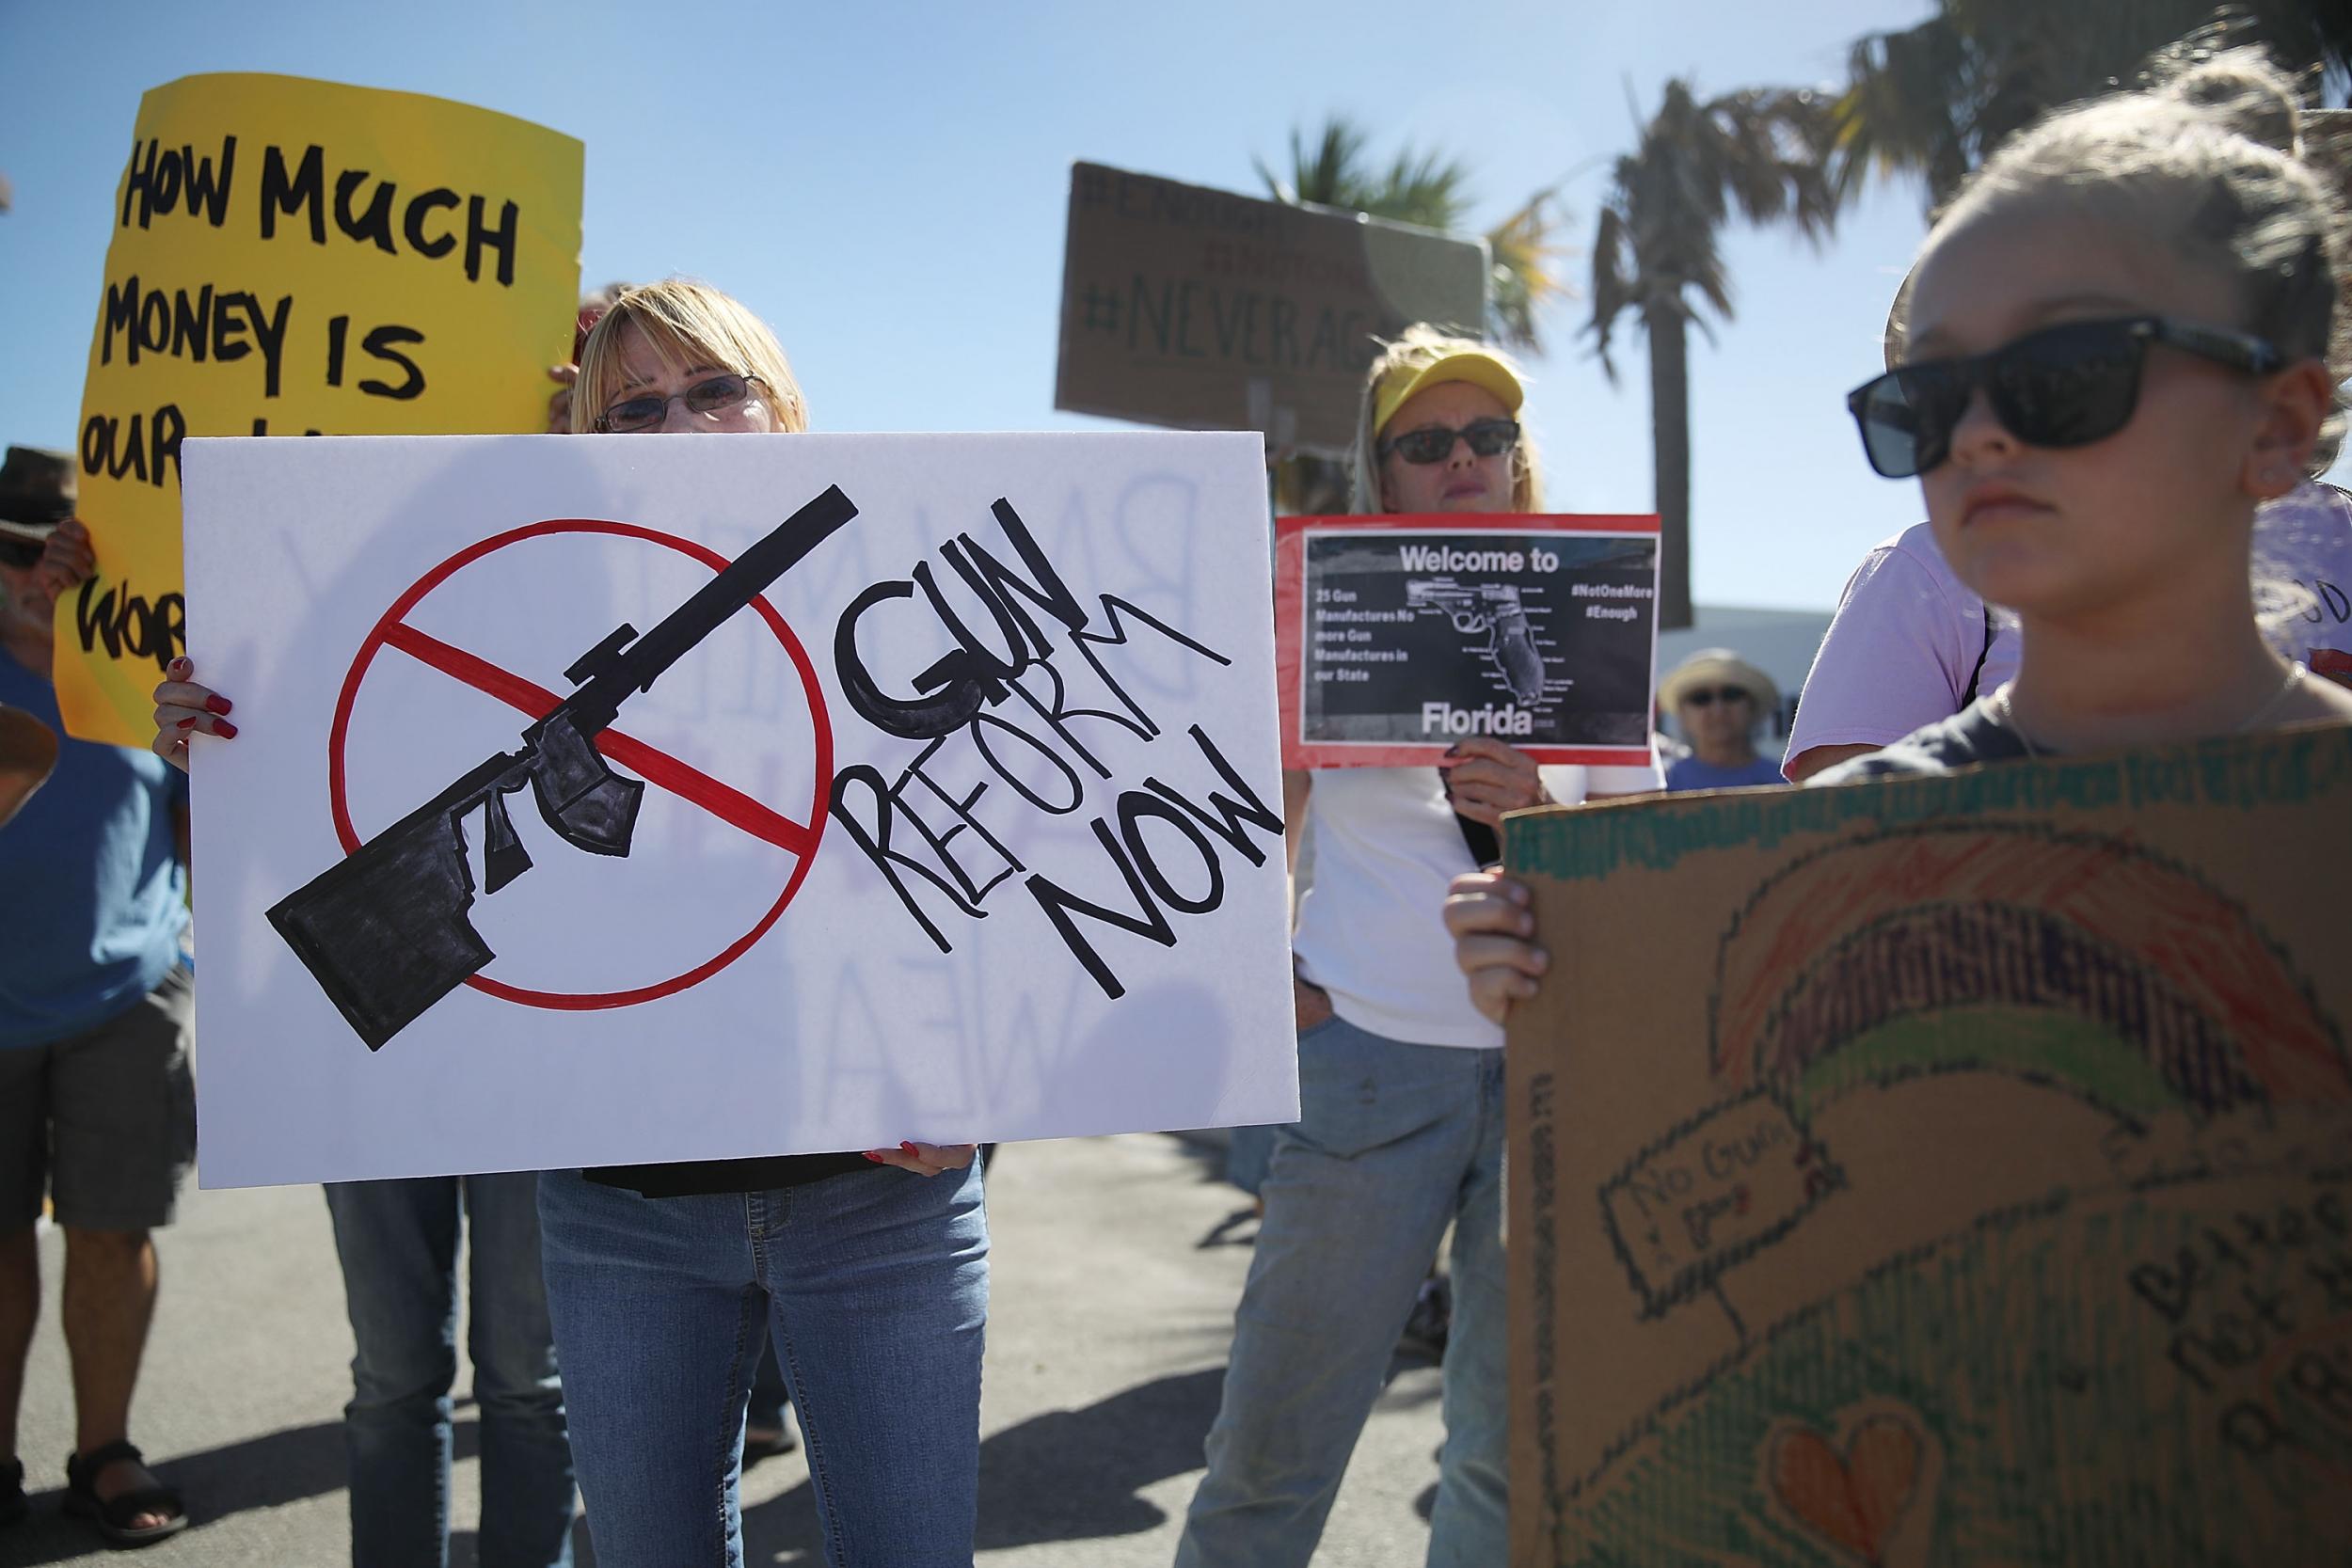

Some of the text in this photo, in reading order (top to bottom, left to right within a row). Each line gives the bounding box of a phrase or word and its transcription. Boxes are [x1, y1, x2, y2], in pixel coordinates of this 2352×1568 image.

[122, 135, 237, 230] HOW
[102, 275, 426, 401] MONEY IS
[83, 404, 186, 496] OUR
[1399, 546, 1560, 574] Welcome to
[1332, 589, 1358, 603] Gun
[1571, 583, 1654, 599] #NotOneMore
[76, 575, 187, 673] WOR
[834, 497, 1089, 740] GUN
[1316, 609, 1396, 623] Manufactures
[1396, 609, 1415, 623] No
[1585, 604, 1638, 623] #Enough
[1314, 627, 1373, 642] more Gun
[1314, 647, 1408, 662] Manufactures in
[1314, 668, 1370, 682] our State
[1422, 702, 1533, 736] Florida
[828, 593, 1232, 954] REFORM
[1025, 722, 1285, 1001] NOW
